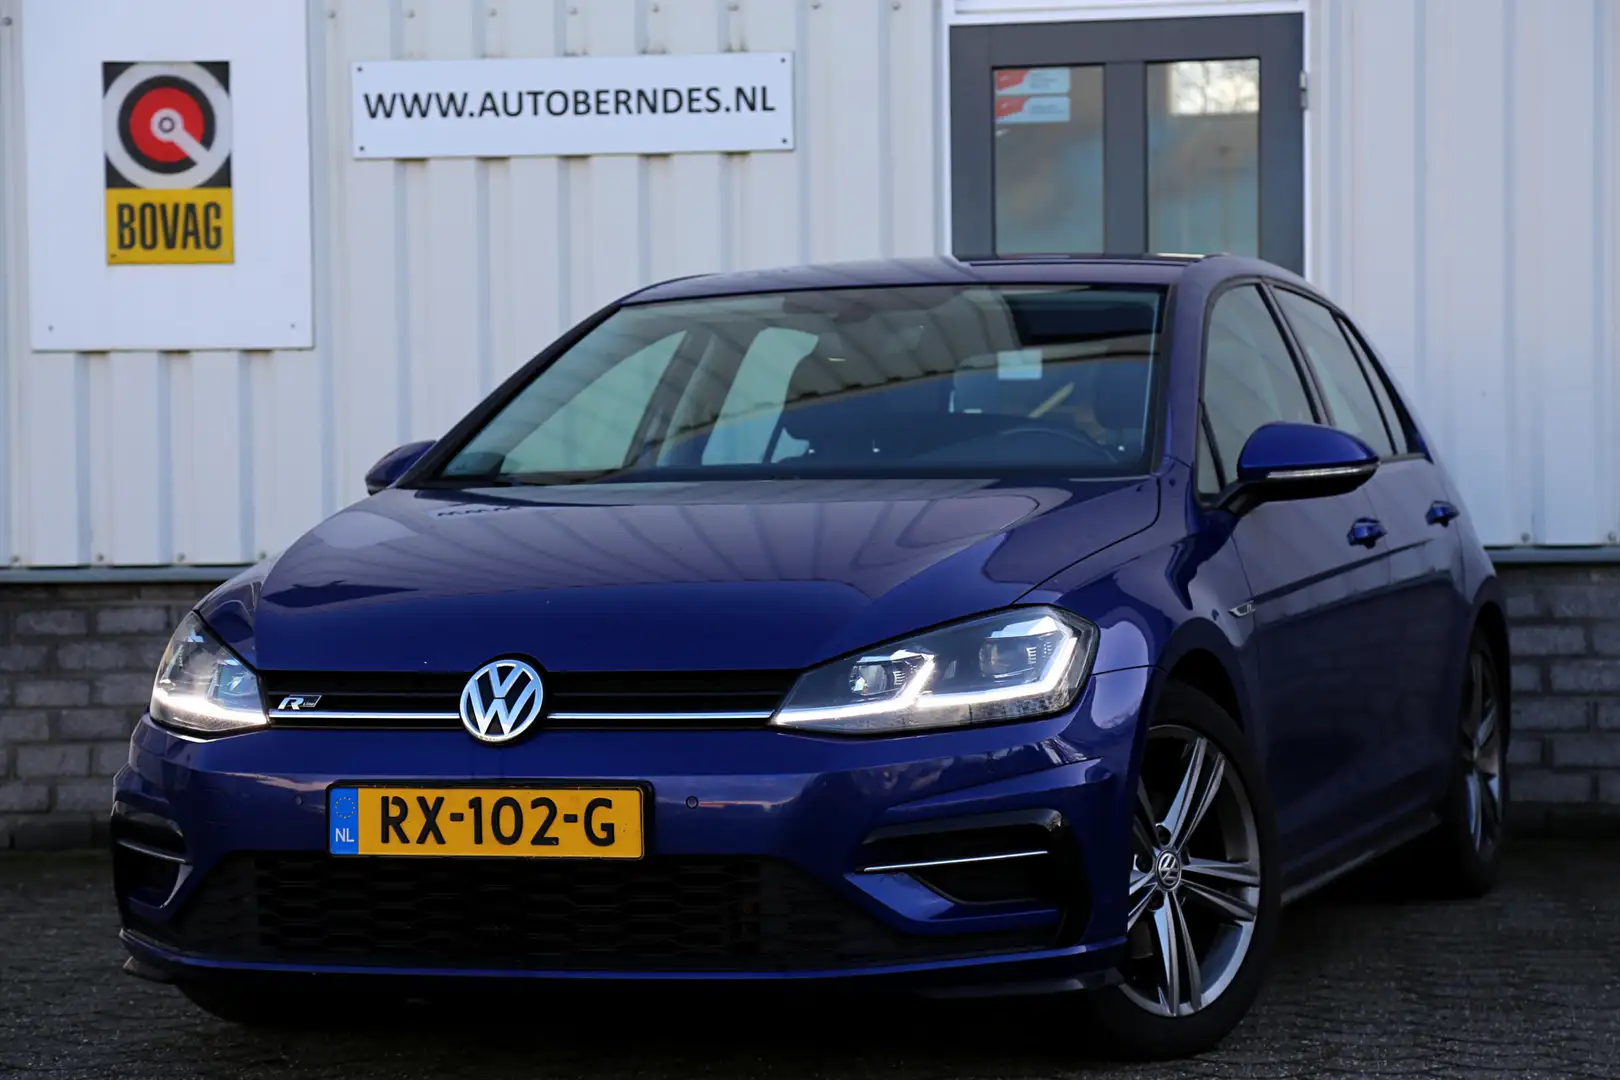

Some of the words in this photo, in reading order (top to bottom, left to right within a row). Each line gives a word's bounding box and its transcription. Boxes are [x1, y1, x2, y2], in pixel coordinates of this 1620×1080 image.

[363, 86, 776, 119] WWW.AUTOBERNDES.NL
[117, 201, 223, 250] BOVAG
[335, 828, 355, 843] NL
[380, 796, 616, 847] RX-102-G
